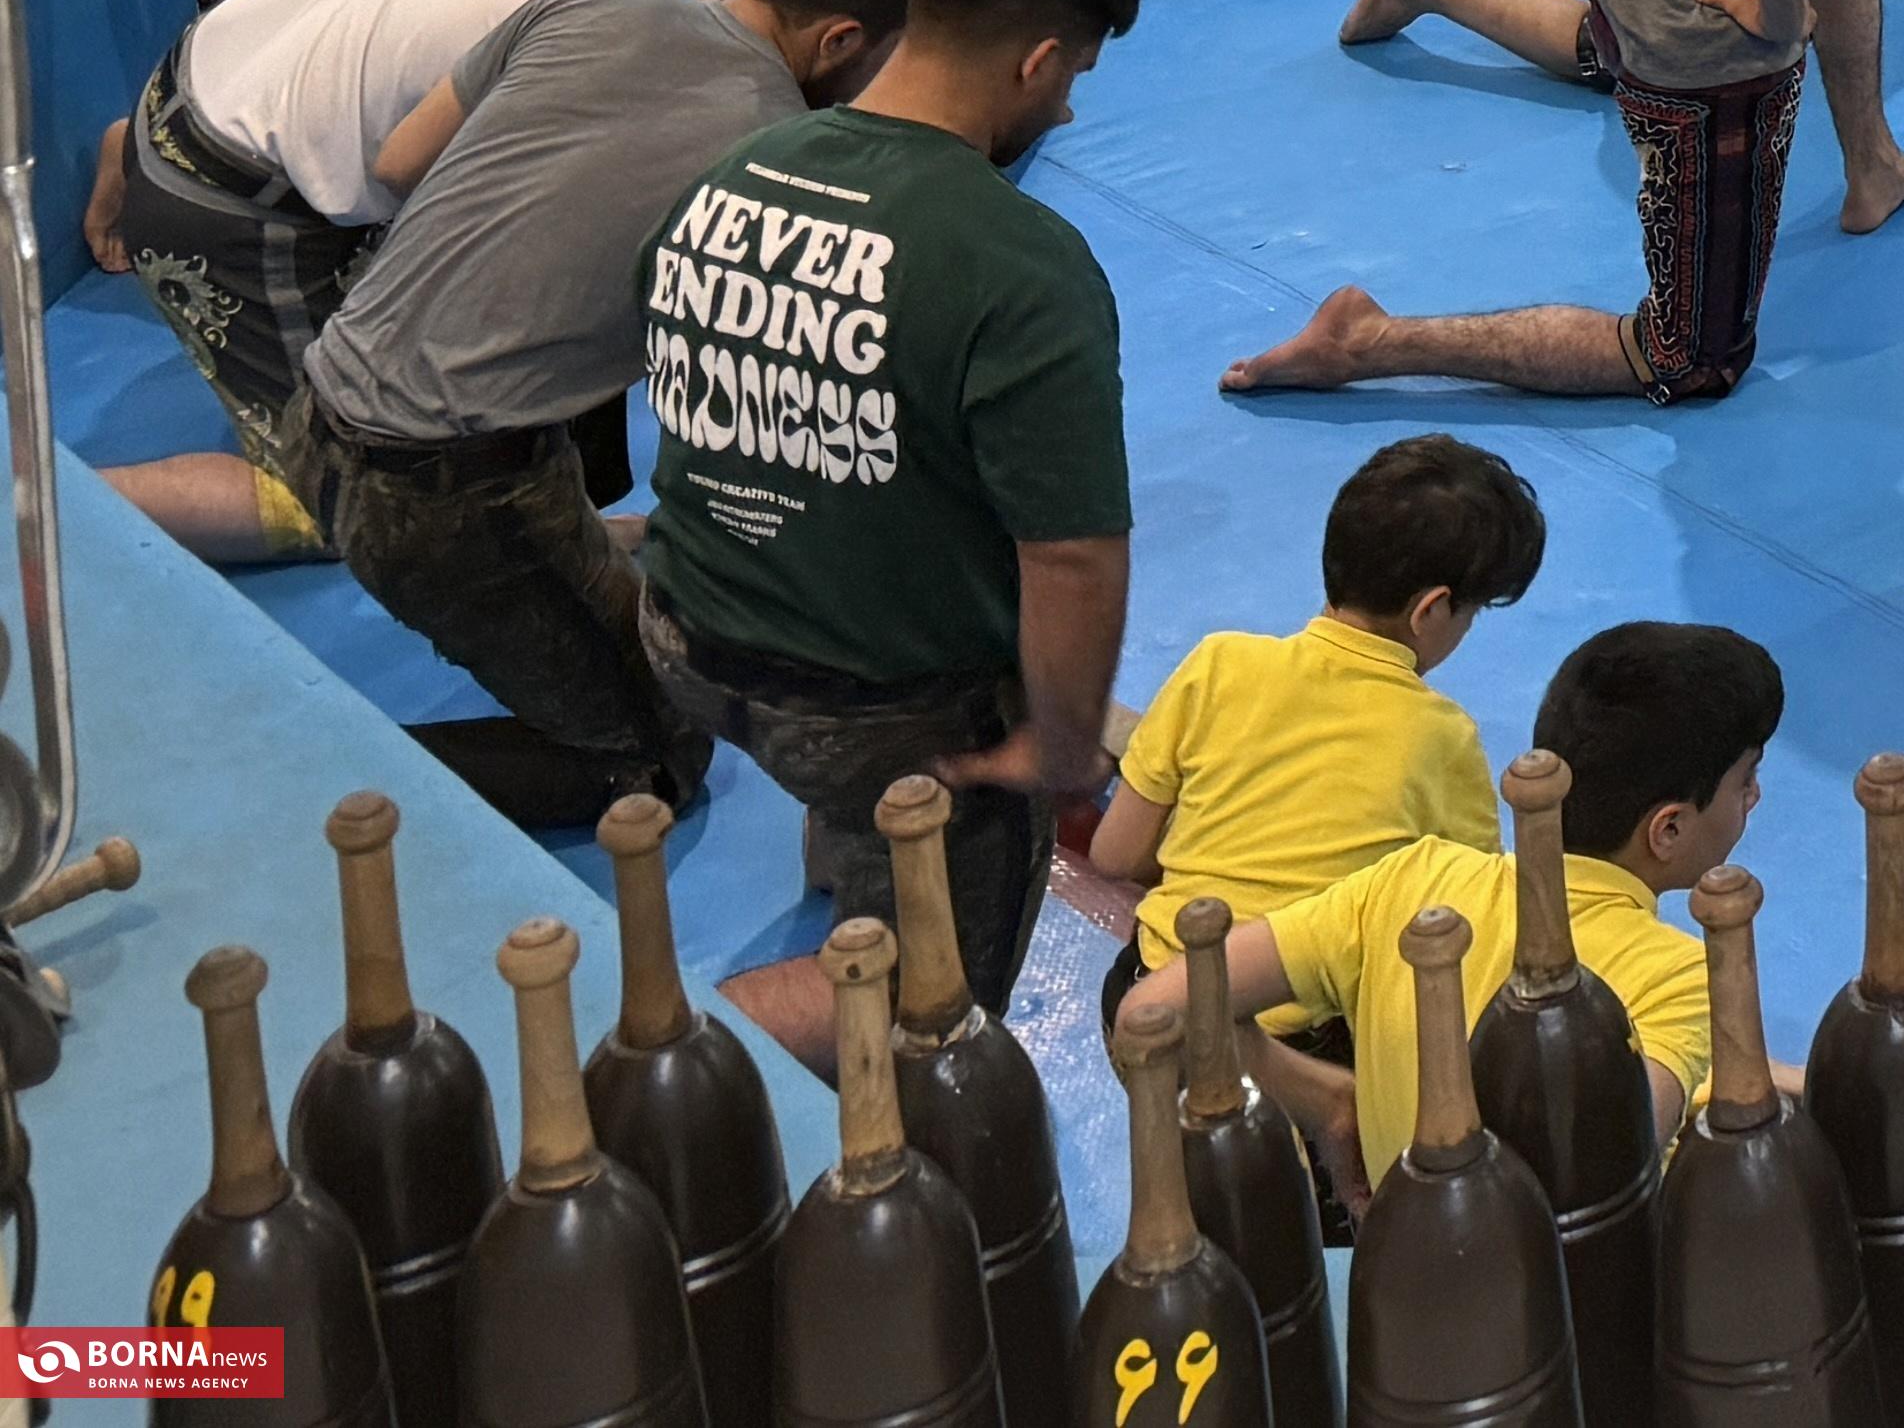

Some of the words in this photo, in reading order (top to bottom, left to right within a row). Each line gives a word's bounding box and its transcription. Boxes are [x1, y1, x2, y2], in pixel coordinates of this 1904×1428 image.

[671, 183, 895, 303] NEVER
[648, 245, 889, 376] ENDING
[645, 321, 898, 486] MADNESS
[720, 482, 776, 503] CREATIVE
[1113, 1329, 1220, 1426] ۶۶
